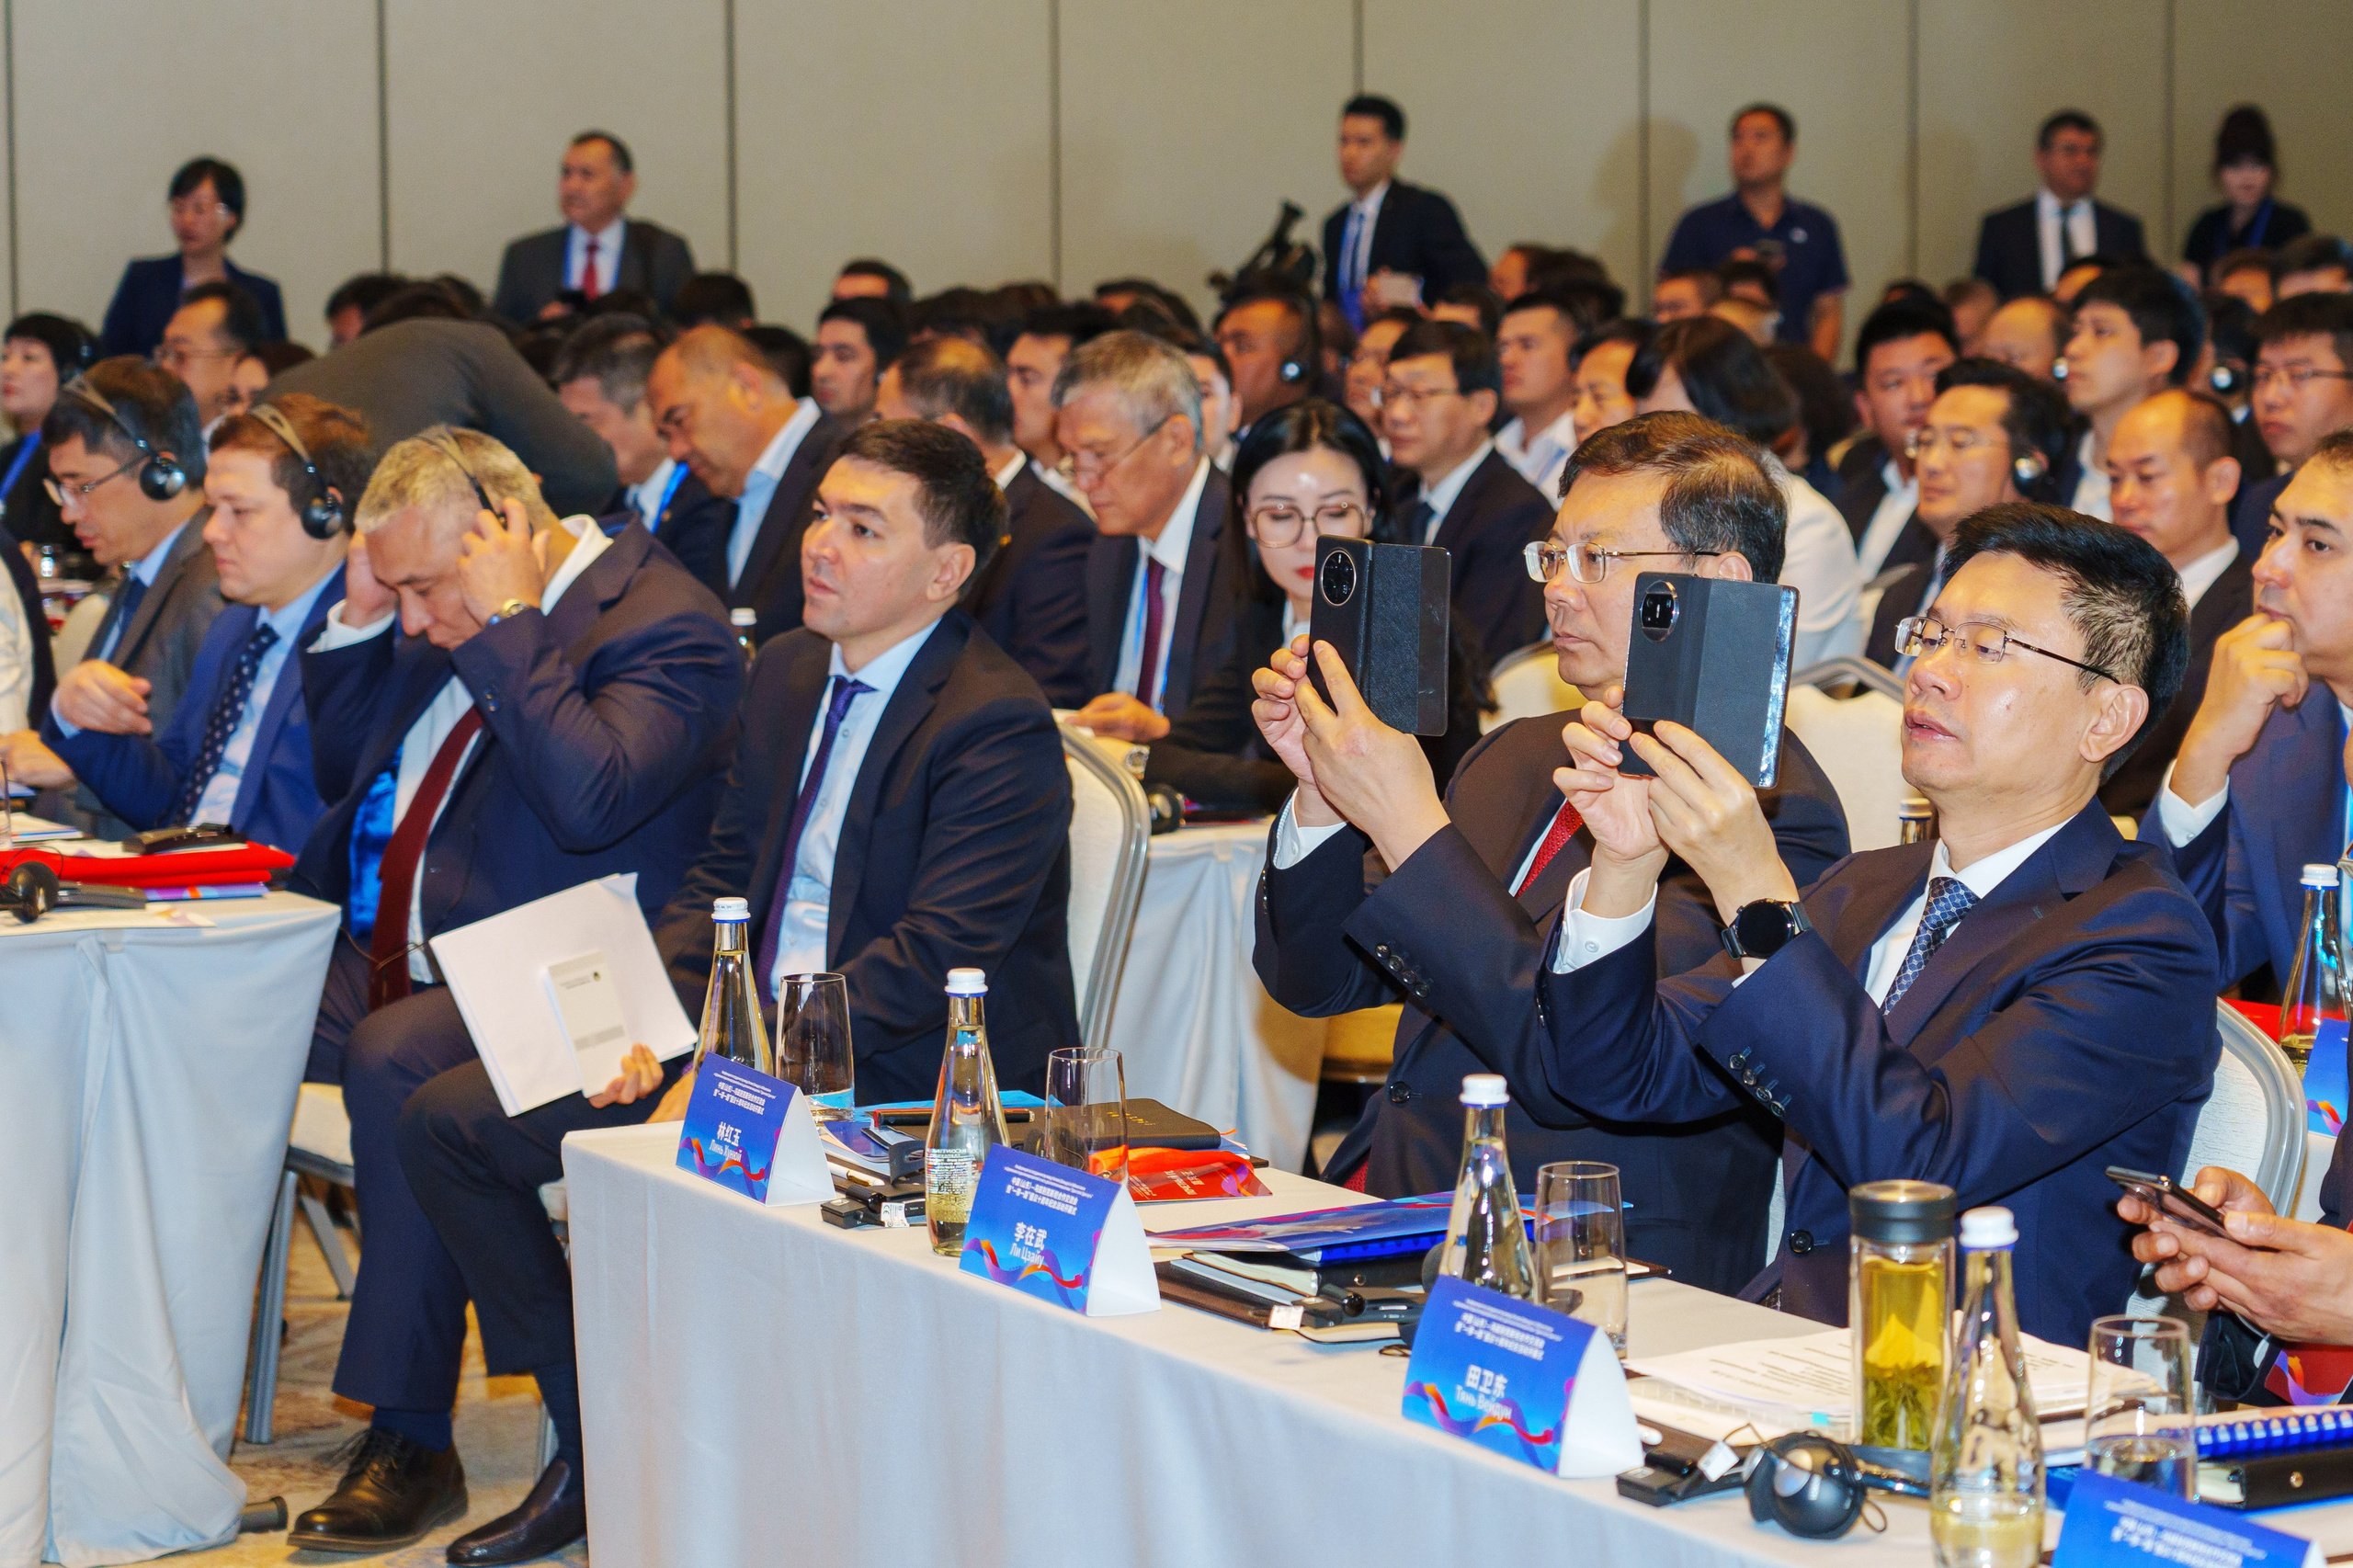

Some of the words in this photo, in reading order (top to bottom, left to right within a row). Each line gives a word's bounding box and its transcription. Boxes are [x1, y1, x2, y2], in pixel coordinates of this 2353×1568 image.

[717, 1121, 742, 1147] 林红玉
[1014, 1221, 1048, 1251] 李在武
[1009, 1242, 1022, 1258] Ли
[1465, 1364, 1509, 1399] 田卫东
[1455, 1384, 1476, 1407] Тянь
